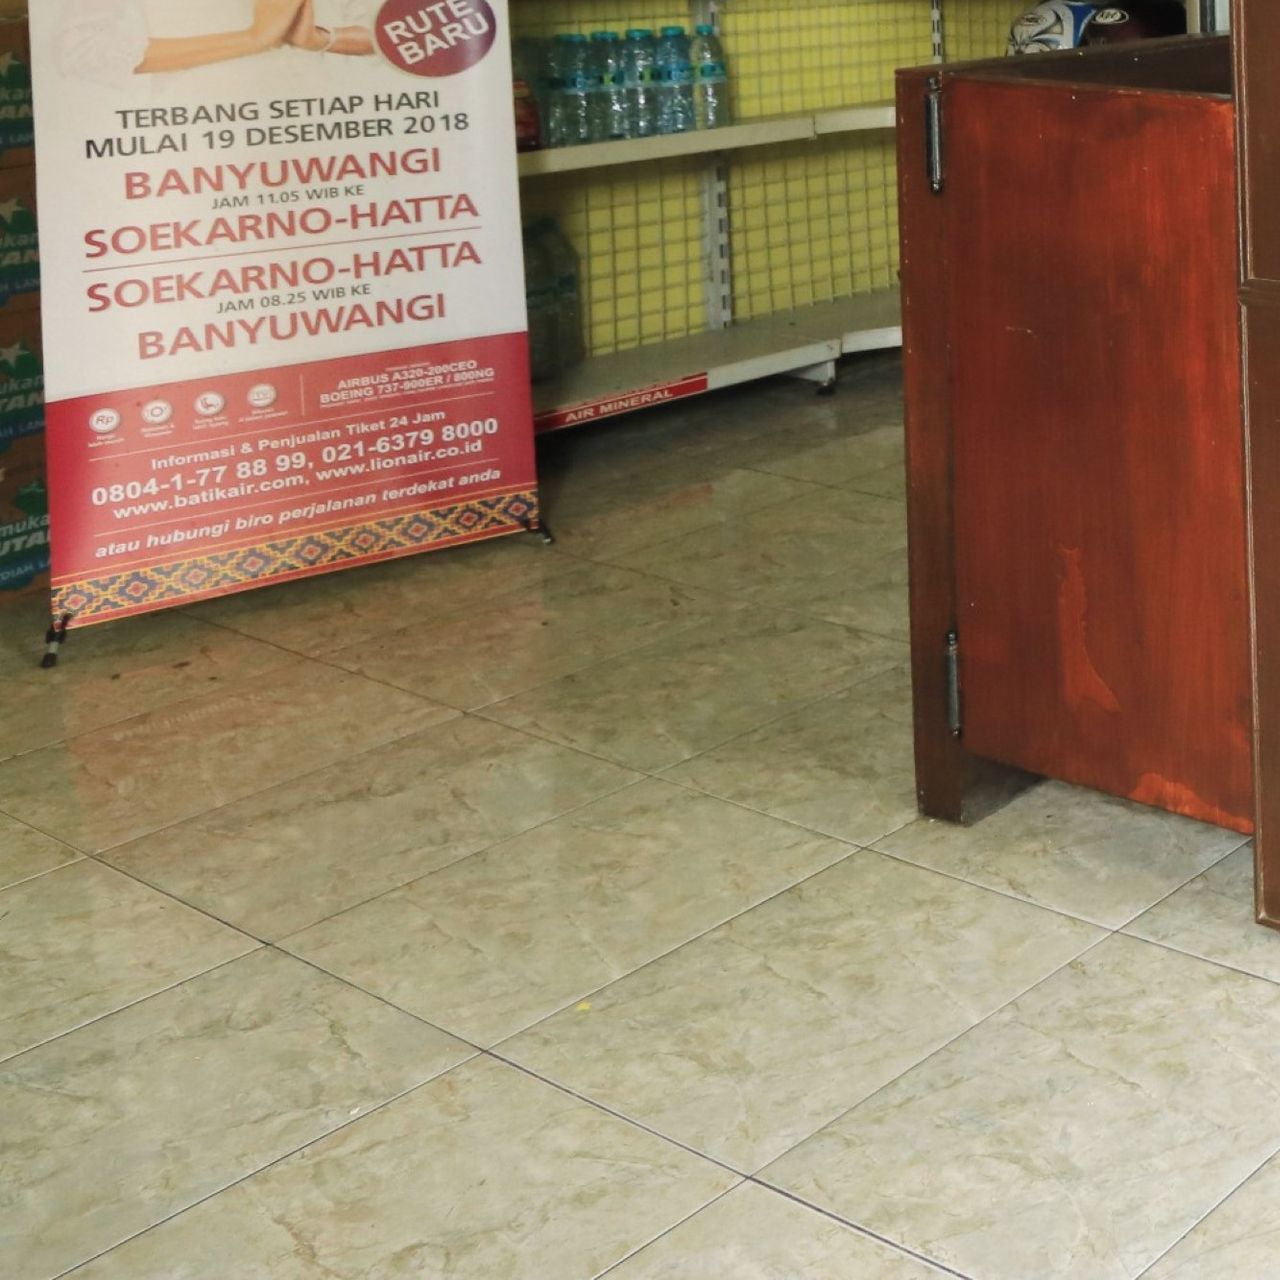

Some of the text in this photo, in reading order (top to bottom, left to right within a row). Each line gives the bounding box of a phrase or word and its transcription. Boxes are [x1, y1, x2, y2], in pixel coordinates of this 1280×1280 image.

[396, 11, 490, 65] BARU
[115, 90, 439, 130] TERBANG SETIAP HARI
[85, 112, 469, 159] MULAI 19 DESEMBER 2018
[124, 147, 441, 201] BANYUWANGI
[211, 183, 365, 210] JAM 11.05 WIB KE
[84, 193, 480, 258] SOEKARNO-HATTA
[86, 240, 483, 313] SOEKARNO-HATTA
[216, 282, 372, 314] JAM 08.25 WIB KE
[138, 293, 447, 361] BANYUWANGI
[319, 386, 374, 404] BOEING
[337, 374, 389, 391] AIRBUS
[565, 388, 674, 423] AIR MINERAL
[91, 418, 499, 506] 0804-1-77 88 99, 021-6379 8000
[151, 410, 446, 470] Informasi & Penjualan Tiket 24 Jam
[315, 439, 483, 481] www.lionair.co.id
[95, 468, 502, 559] atau hubungi biro perjalanan terdekat anda
